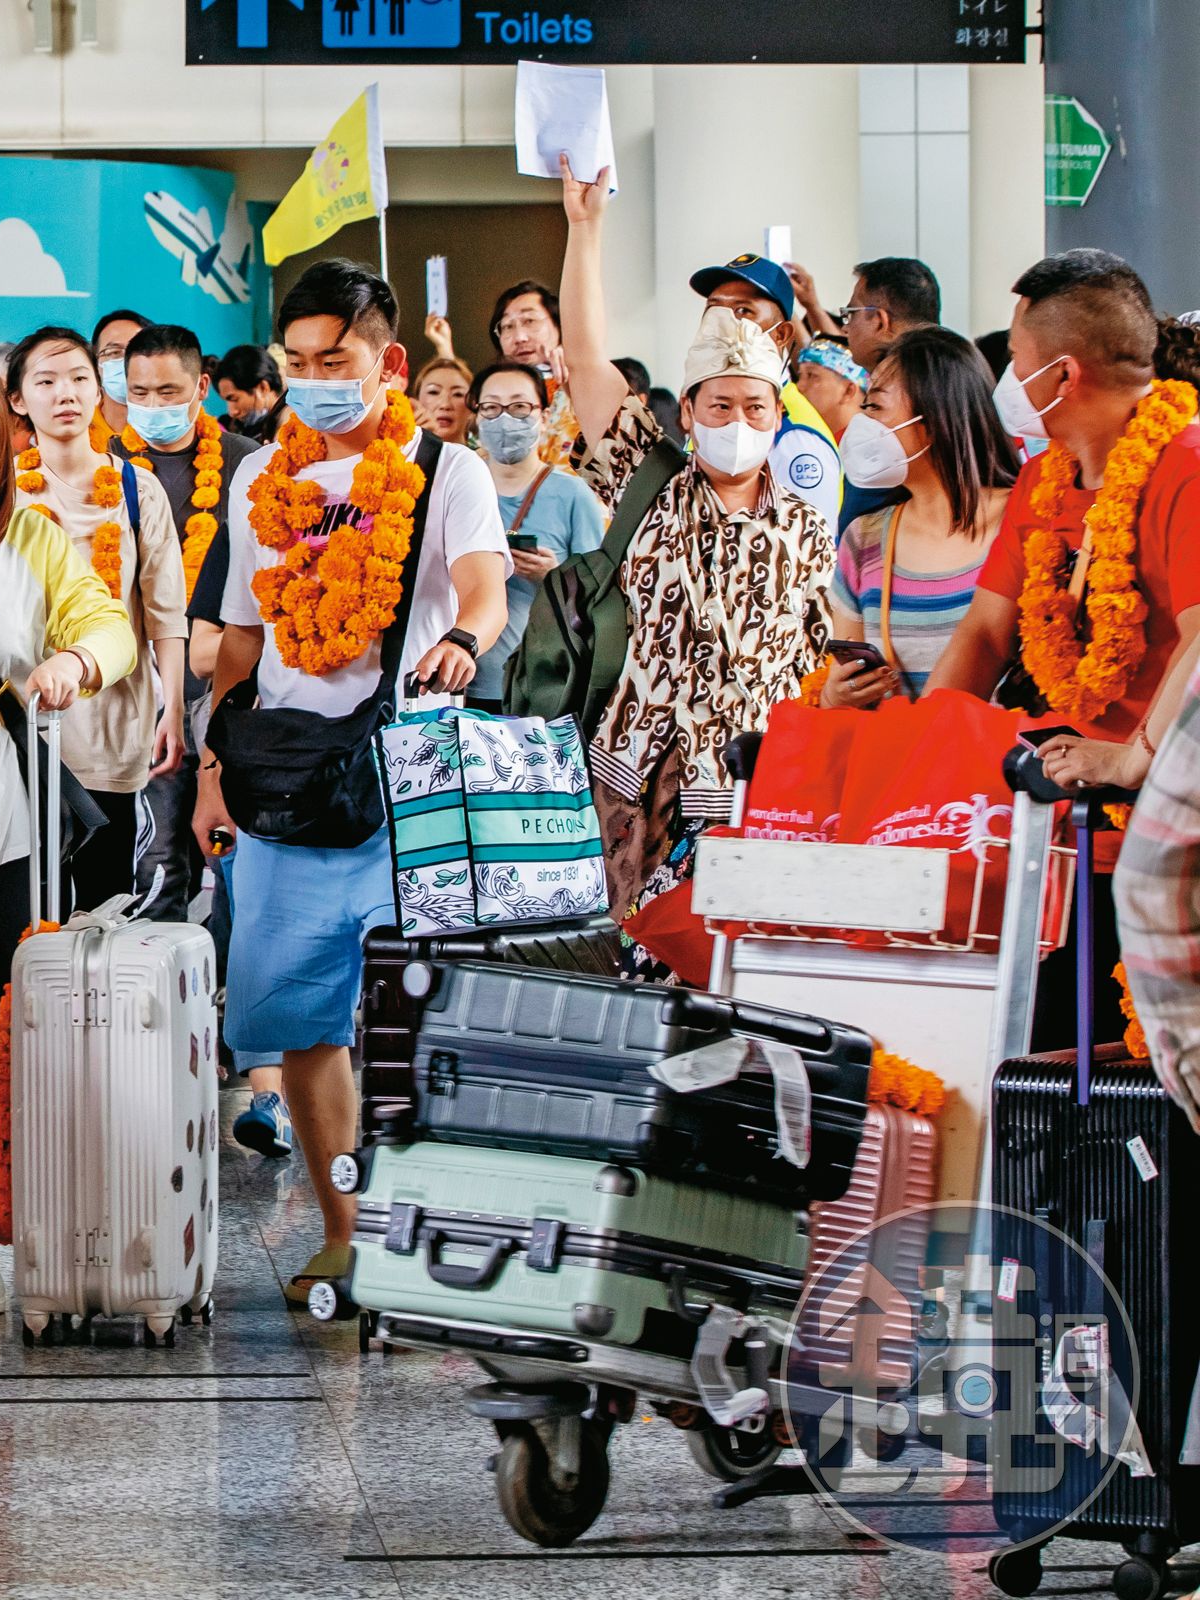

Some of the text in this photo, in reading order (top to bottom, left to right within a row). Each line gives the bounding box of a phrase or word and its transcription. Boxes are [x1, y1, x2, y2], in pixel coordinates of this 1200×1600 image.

[475, 11, 593, 44] Toilets
[954, 27, 1008, 47] 화장실
[1061, 143, 1101, 156] TSUNAMI
[795, 463, 818, 474] DPS
[536, 866, 579, 882] since 1931
